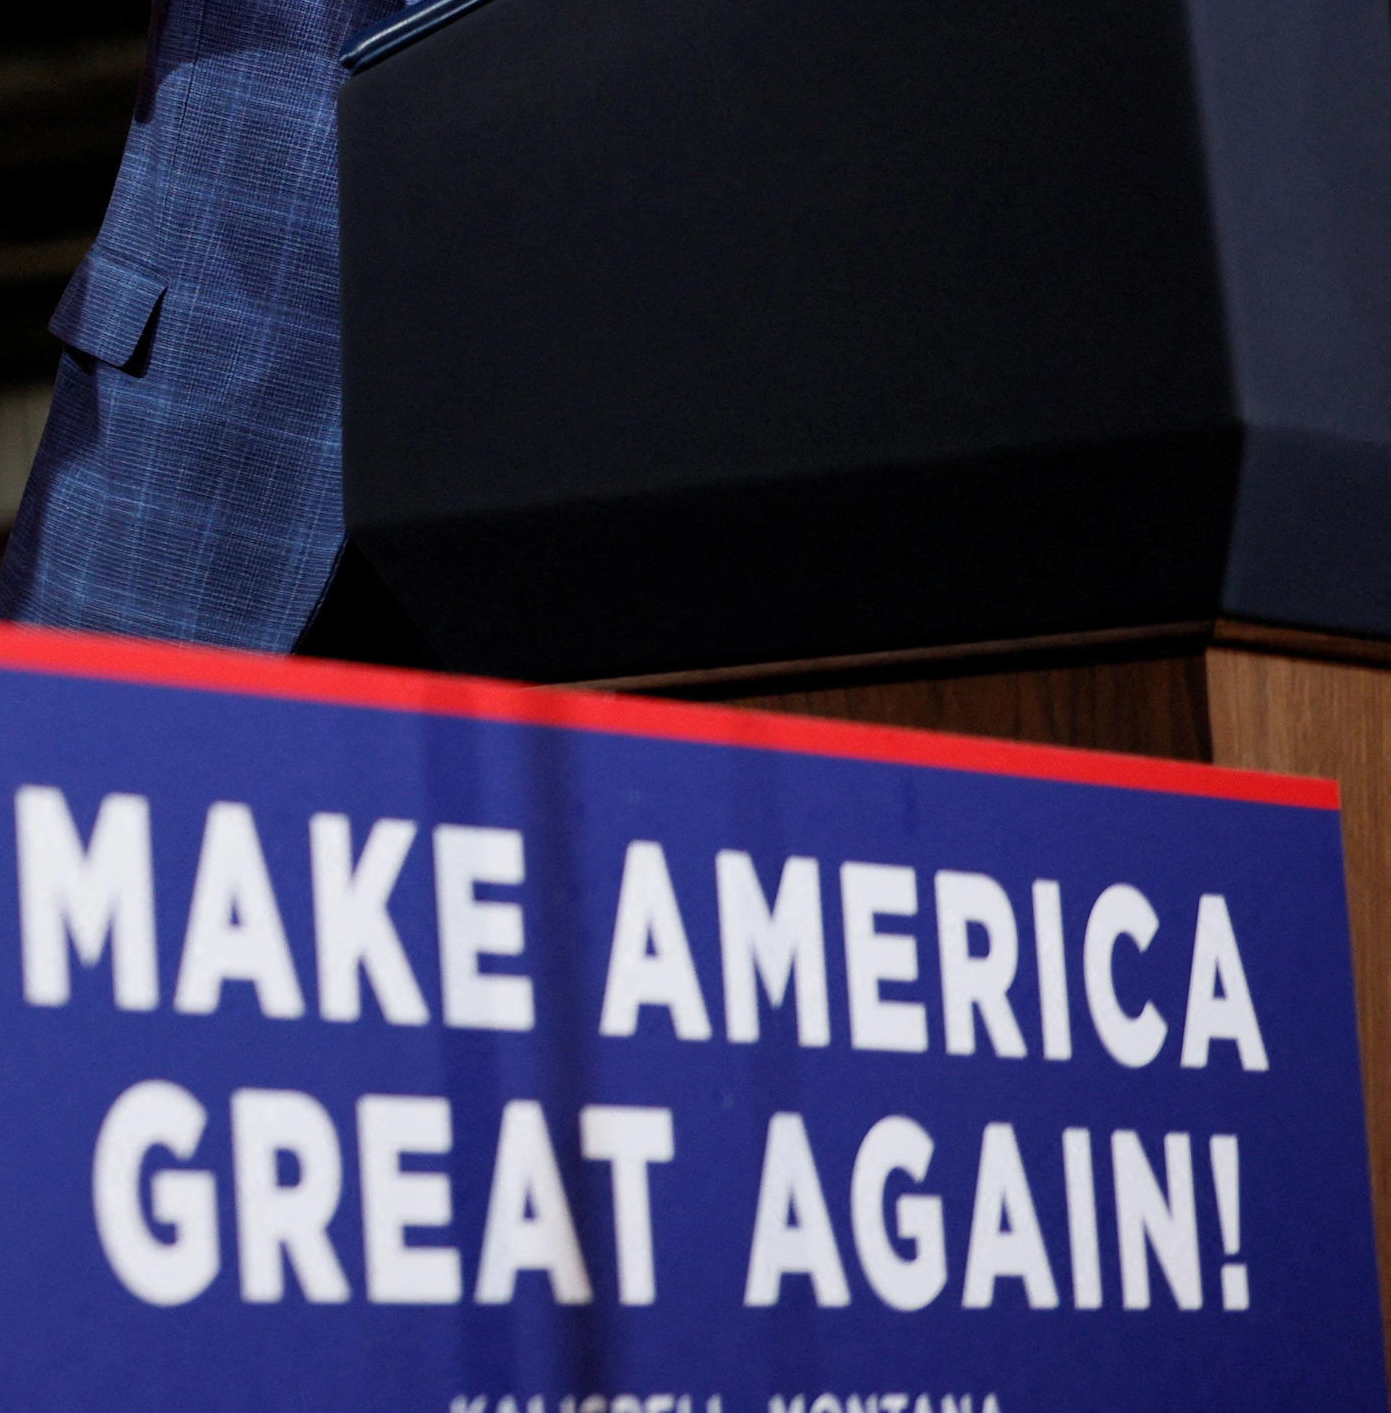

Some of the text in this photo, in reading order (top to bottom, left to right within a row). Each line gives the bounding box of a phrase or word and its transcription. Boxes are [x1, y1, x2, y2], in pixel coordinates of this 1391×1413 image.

[13, 784, 1271, 1074] MAKE AMERICA
[91, 1079, 1251, 1313] GREAT AGAIN!
